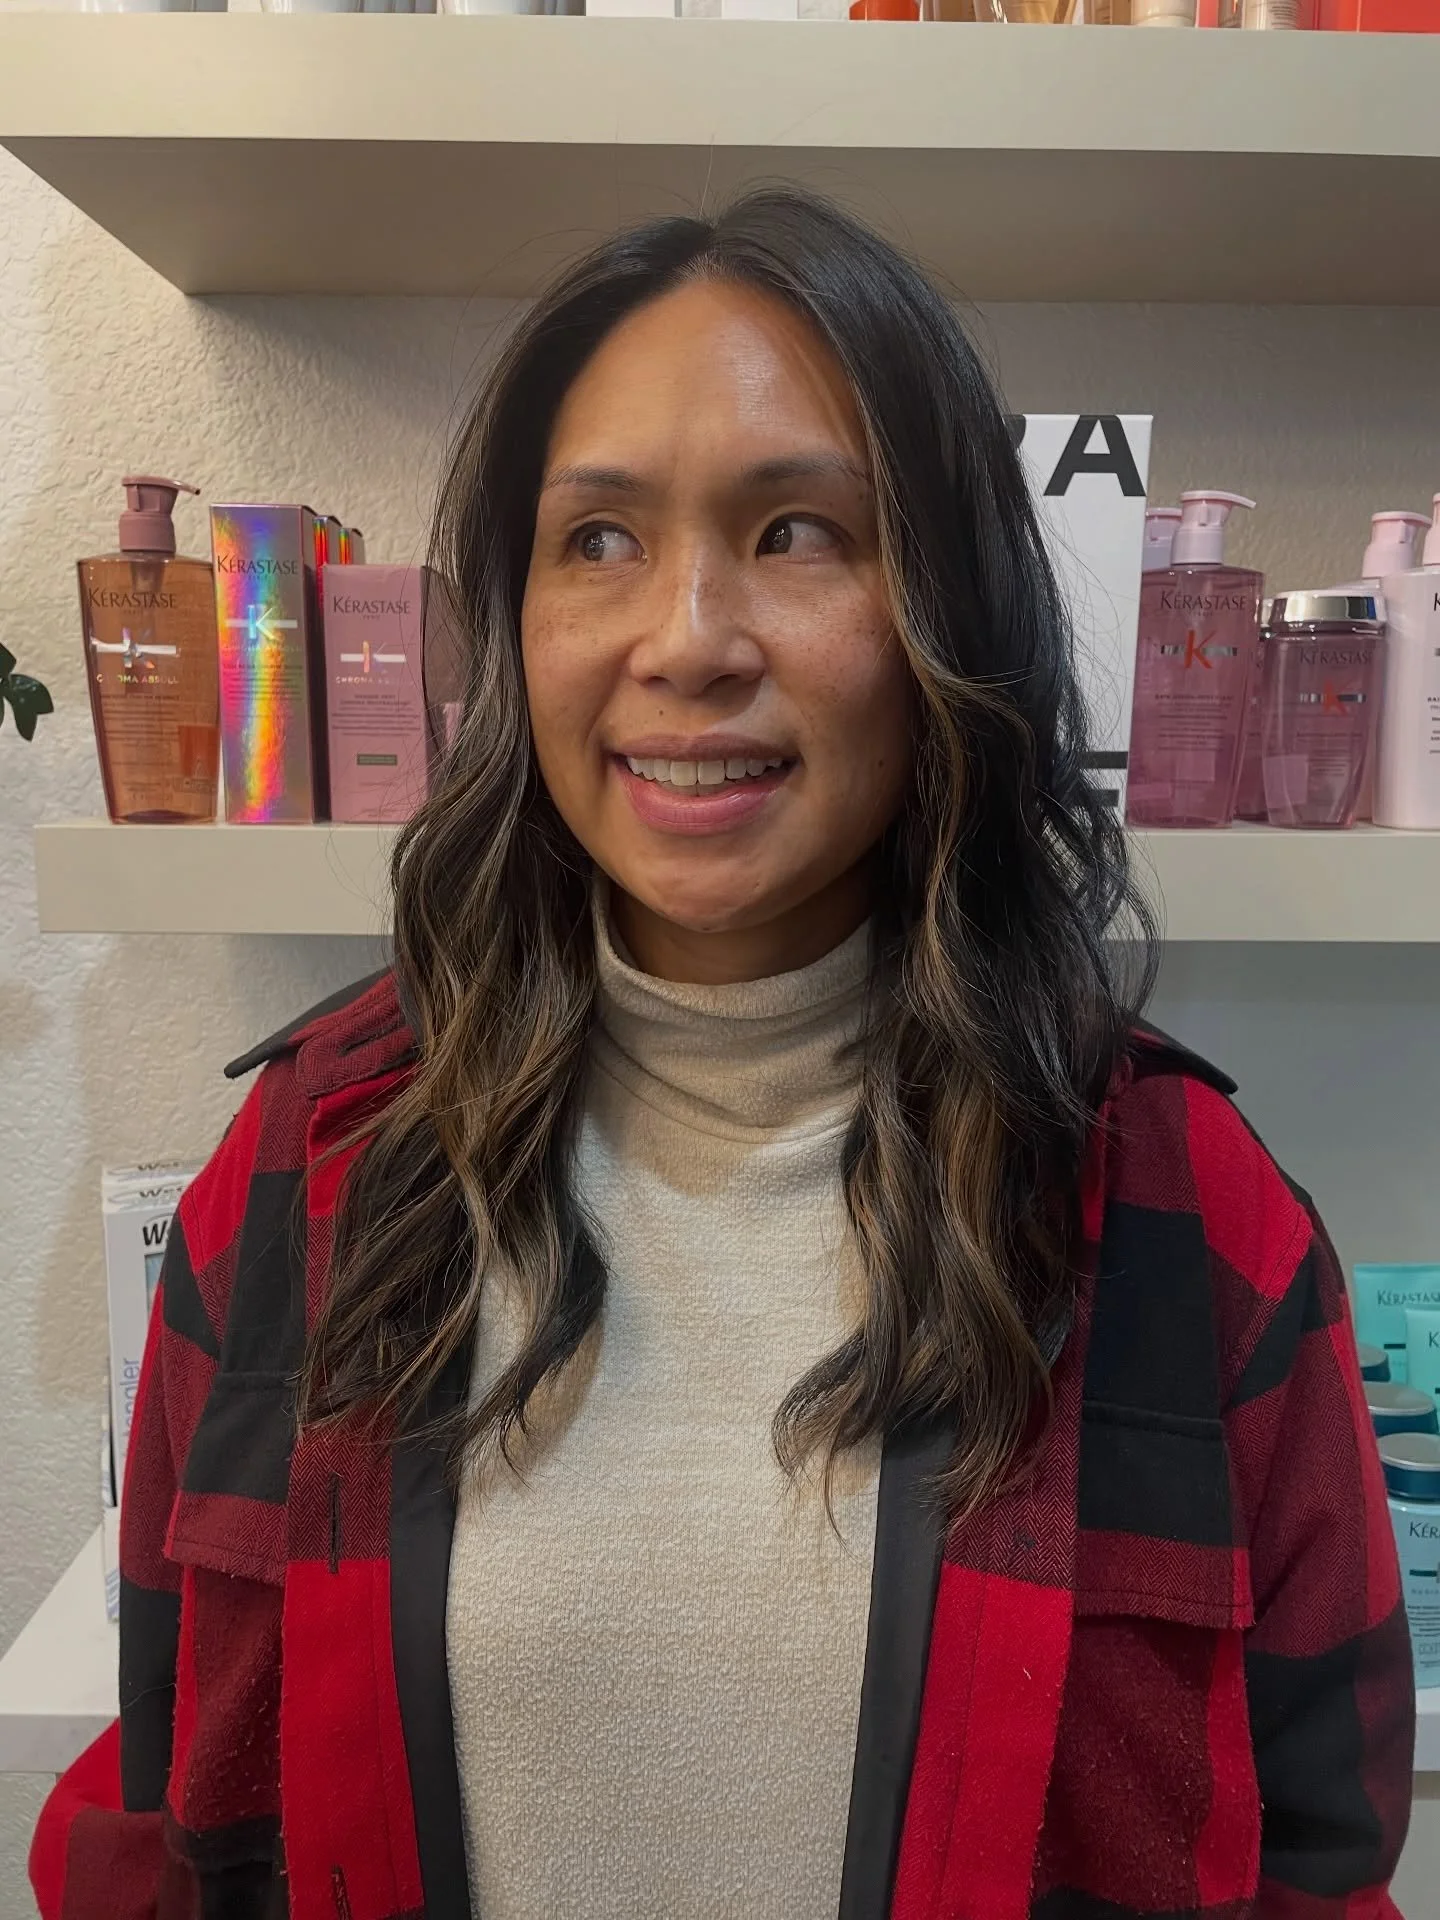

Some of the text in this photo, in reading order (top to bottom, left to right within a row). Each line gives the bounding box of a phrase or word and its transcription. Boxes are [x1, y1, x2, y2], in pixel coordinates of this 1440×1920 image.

[217, 554, 299, 576] KÉRASTASE
[88, 587, 179, 608] KÉRASTASE
[333, 595, 412, 615] KÉRASTASE
